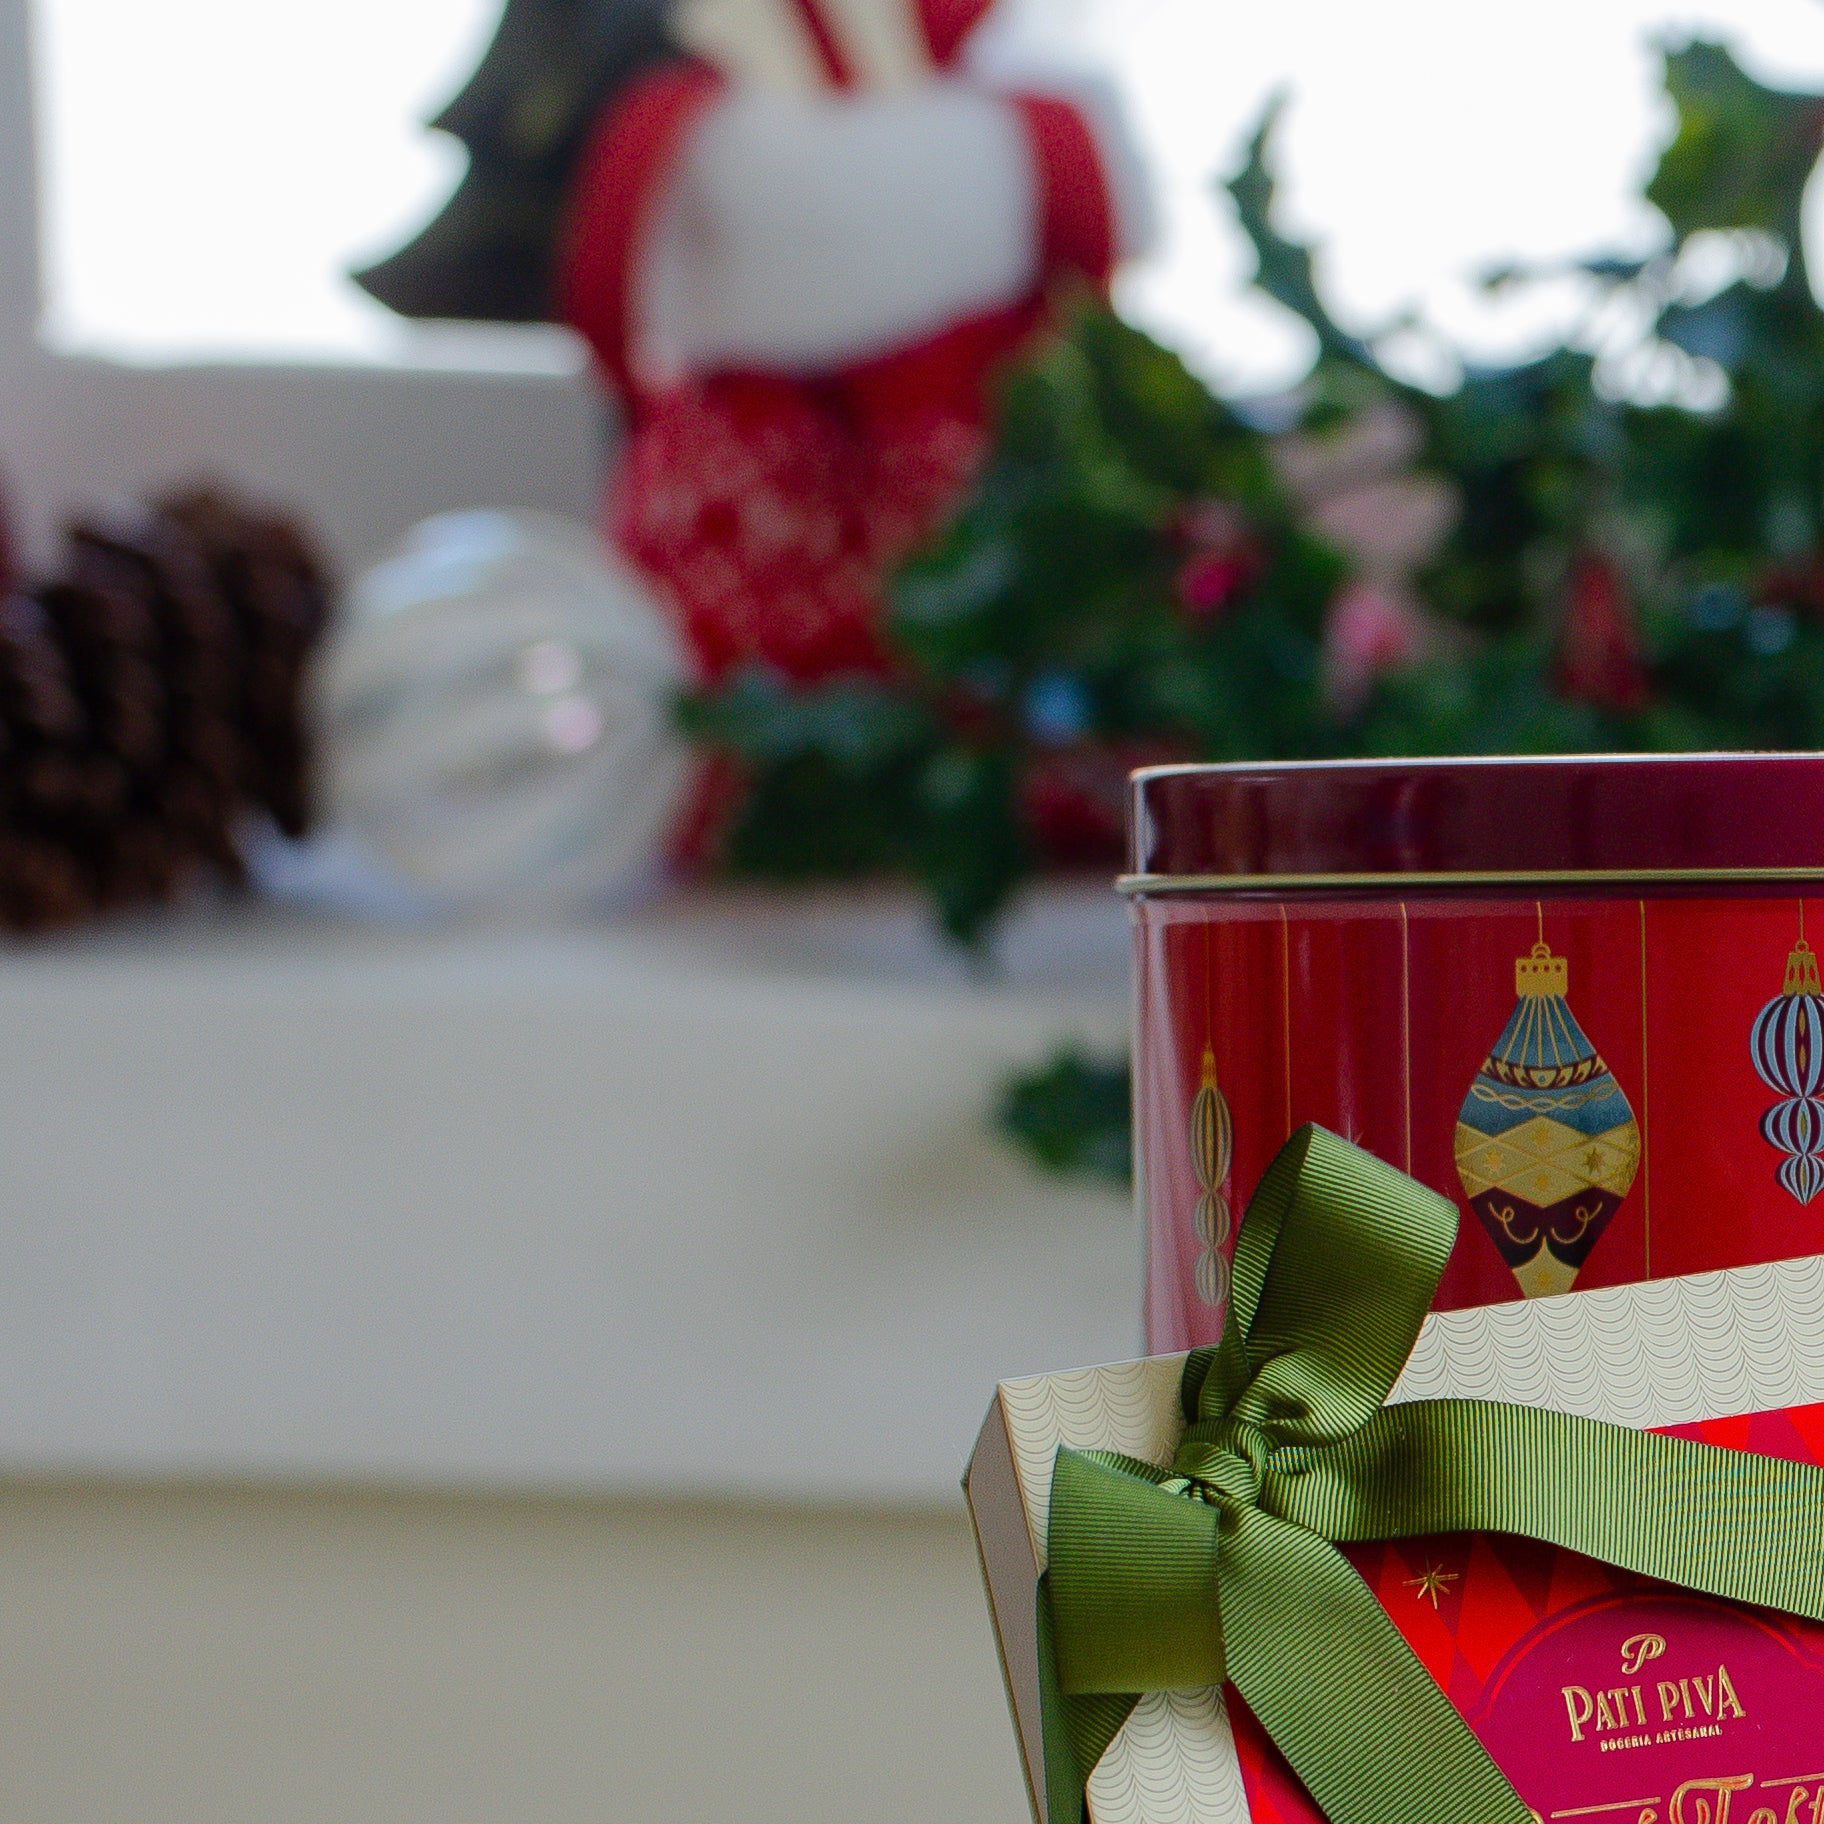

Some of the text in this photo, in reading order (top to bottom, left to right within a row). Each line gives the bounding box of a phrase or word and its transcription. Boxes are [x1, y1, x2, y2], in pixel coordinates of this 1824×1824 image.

[1562, 1664, 1746, 1742] PATI PIVA
[1600, 1724, 1723, 1752] DOCERIA ARTESANAL
